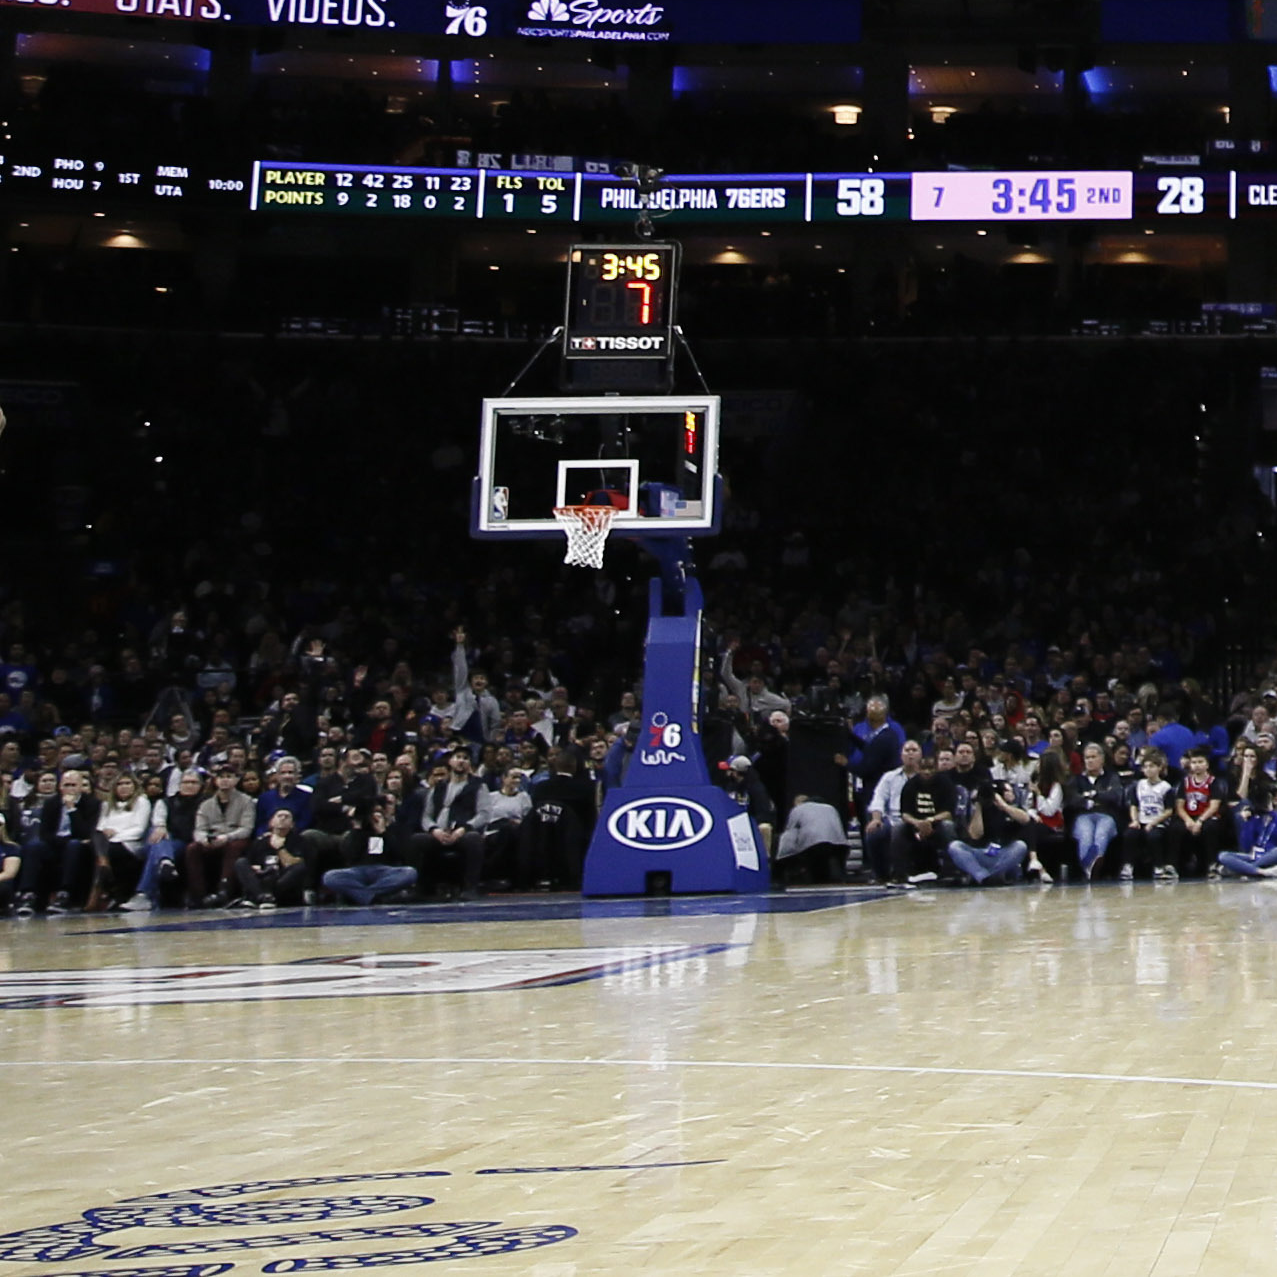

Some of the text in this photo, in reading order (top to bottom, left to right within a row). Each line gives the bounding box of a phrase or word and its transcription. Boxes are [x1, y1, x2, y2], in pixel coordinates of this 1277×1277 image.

[445, 4, 487, 37] 76
[12, 165, 41, 178] 2ND
[54, 158, 105, 172] PHO 9
[156, 165, 189, 179] MEM
[52, 178, 84, 190] HOU
[118, 173, 140, 184] 1ST
[208, 179, 244, 191] 10:00
[265, 171, 472, 191] PLAYER 12 42 25 11 23
[496, 175, 565, 191] FLS TOL
[155, 185, 183, 197] UTA
[264, 189, 466, 211] POINTS 9 2 18 0 2
[725, 188, 786, 209] 76ERS
[836, 178, 885, 216] 58
[932, 178, 1121, 214] 7 3:45 2ND
[1156, 176, 1204, 214] 28
[502, 194, 558, 214] 1 5
[602, 253, 660, 280] 3:45
[627, 283, 650, 324] 7
[597, 336, 664, 349] TISSOT
[650, 723, 681, 748] 76
[627, 808, 697, 839] KIA
